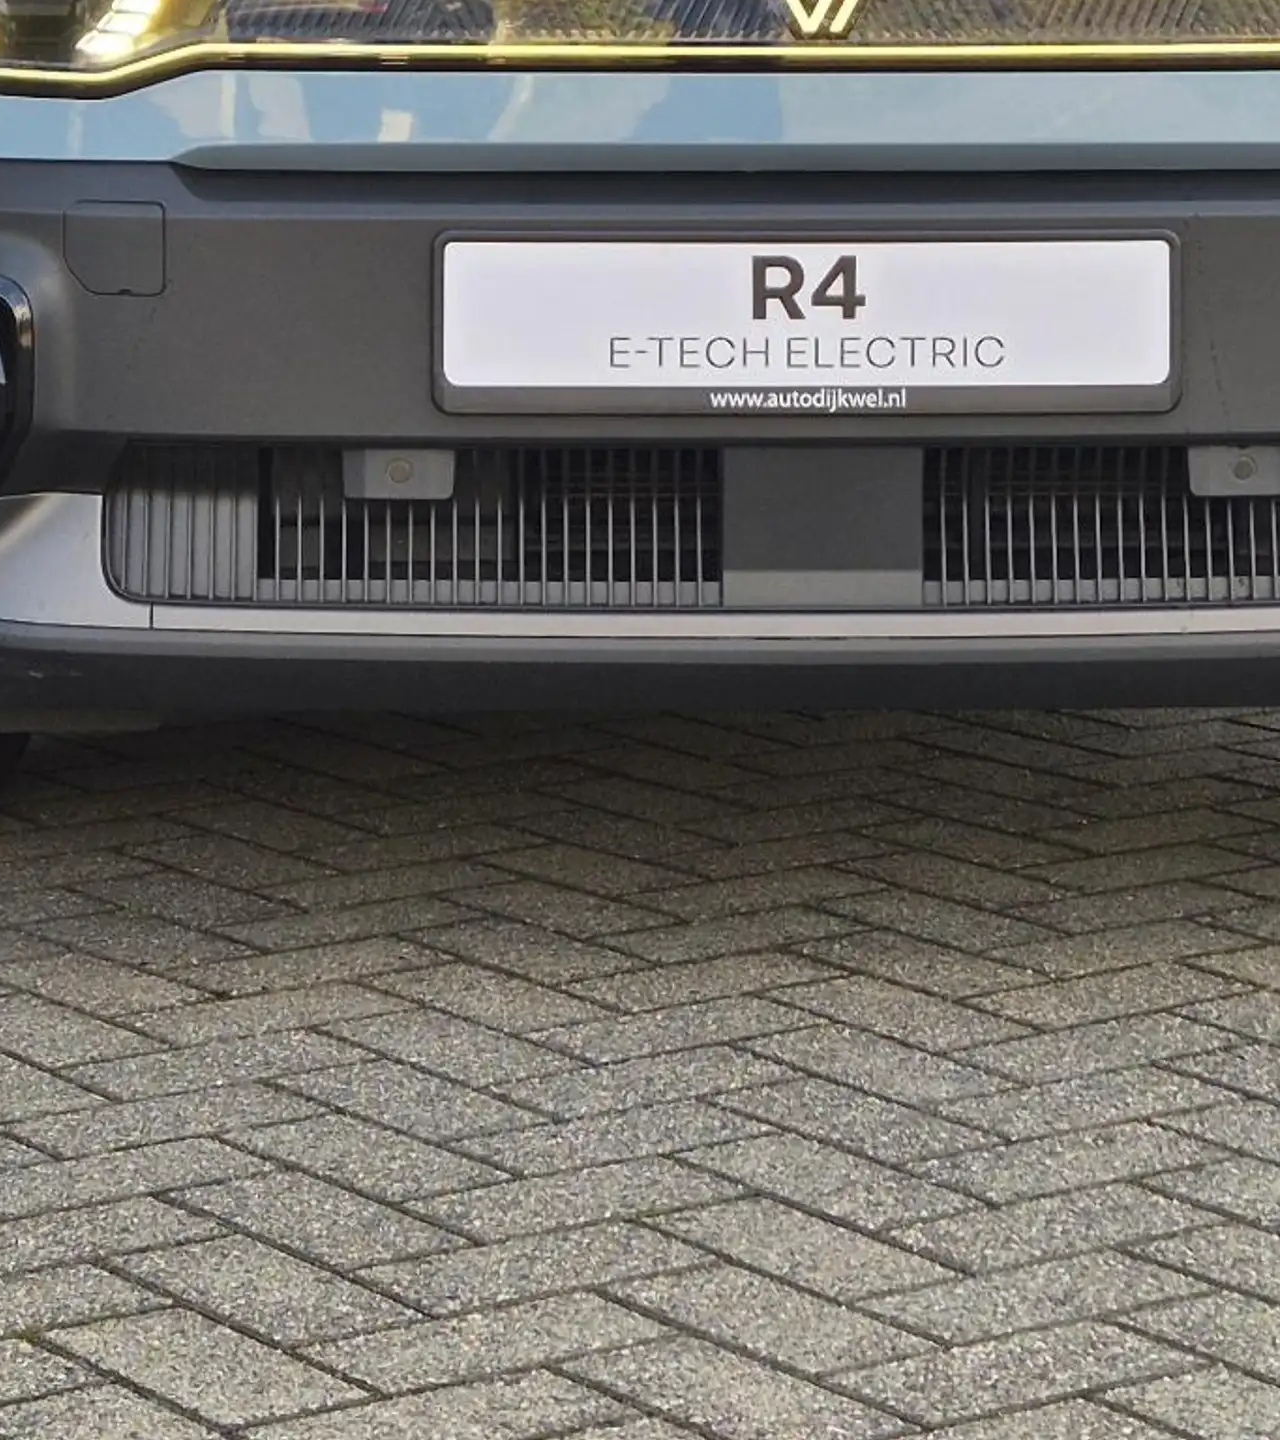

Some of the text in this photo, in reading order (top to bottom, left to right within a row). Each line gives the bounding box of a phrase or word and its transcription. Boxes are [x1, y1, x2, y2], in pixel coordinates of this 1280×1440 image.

[751, 254, 866, 320] R4
[609, 336, 1006, 368] E-TECH ELECTRIC
[709, 388, 907, 412] www.autodijkwel.nl
